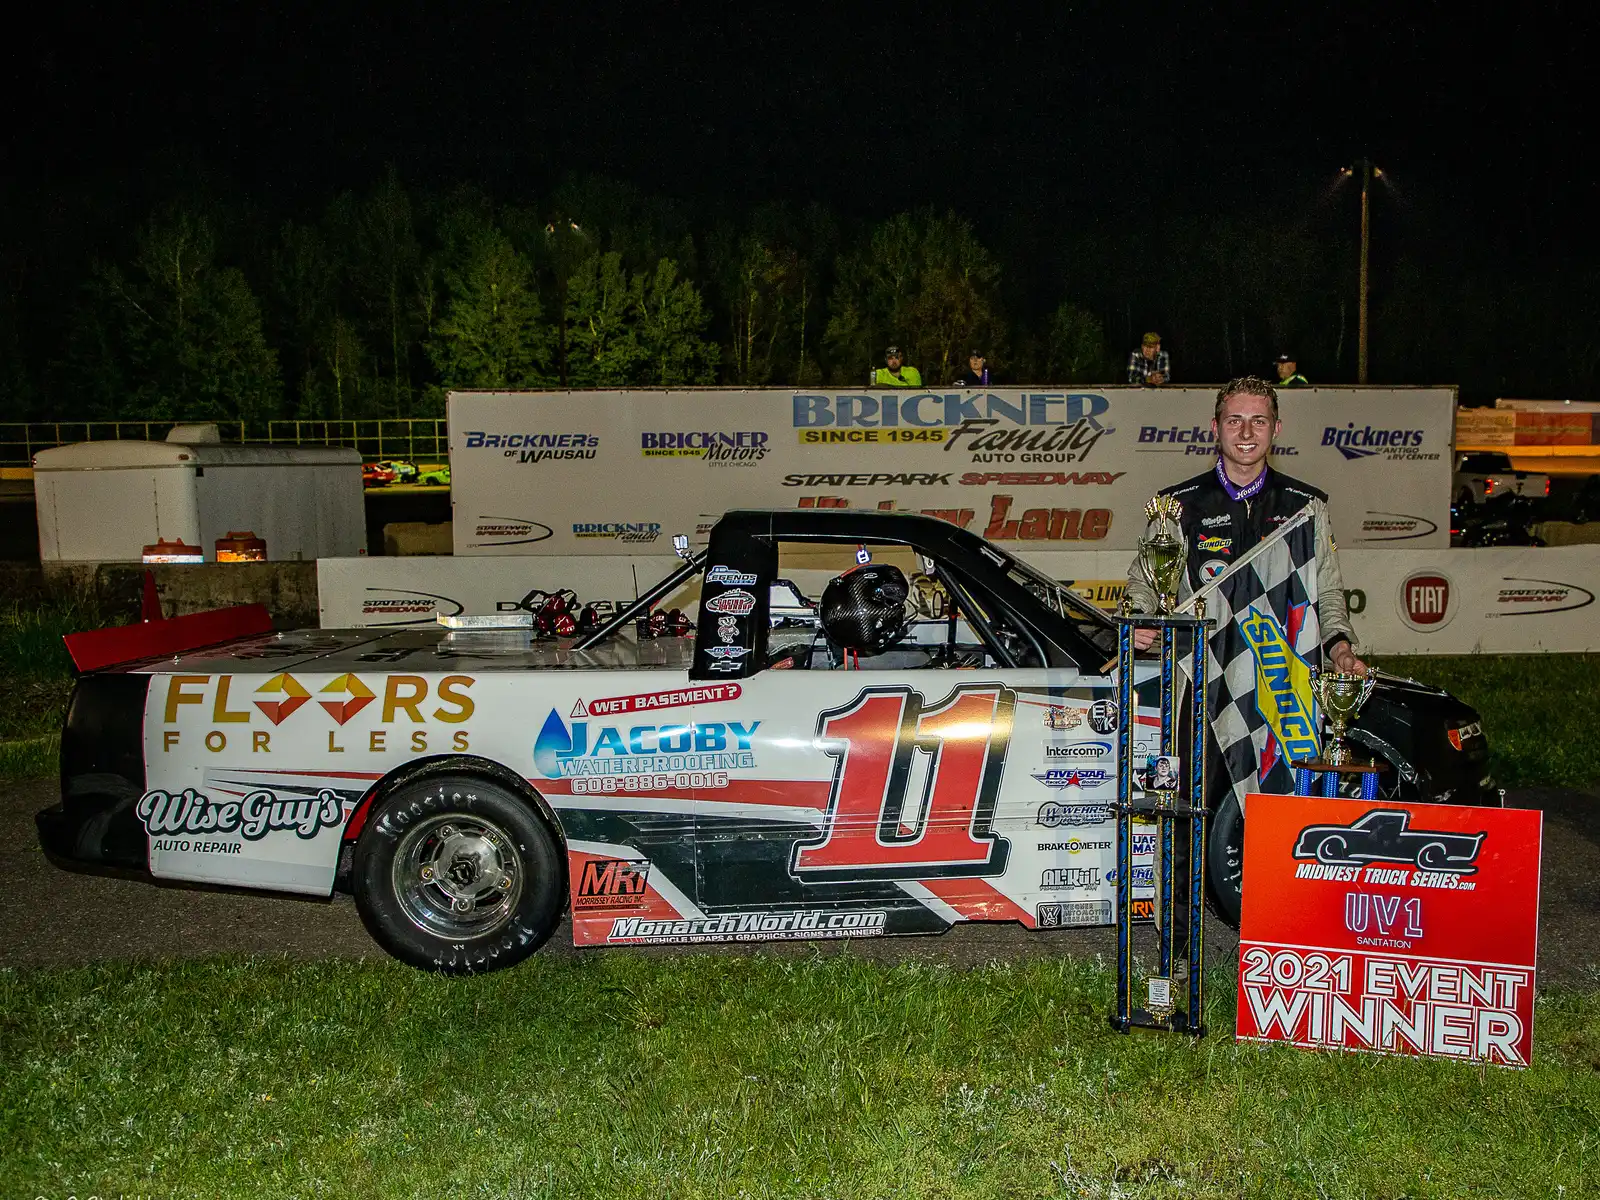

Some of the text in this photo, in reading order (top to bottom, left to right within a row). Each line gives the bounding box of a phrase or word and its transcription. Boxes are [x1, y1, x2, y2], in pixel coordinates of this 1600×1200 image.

[793, 394, 1116, 434] BRICKNER
[641, 432, 769, 449] BRICKNER
[805, 429, 943, 443] SINCE 1945
[944, 418, 1113, 462] Family
[1321, 422, 1424, 447] Brickners
[504, 449, 597, 464] OF WAUSAU
[702, 442, 771, 461] Motors
[972, 453, 1076, 463] AUTO GROUP
[781, 472, 1127, 487] STATEPARK SPEEDWAY
[983, 494, 1114, 541] Lane
[572, 523, 661, 534] BRICKNER
[1198, 539, 1232, 549] SUNOCO
[363, 599, 438, 607] STATEPARK
[1411, 585, 1446, 614] FIAT
[362, 606, 436, 614] SPEEDWAY
[1247, 621, 1317, 761] SUNOCO
[593, 699, 630, 714] WET
[163, 731, 470, 753] FOR LESS
[556, 720, 761, 758] JACOBY
[1046, 746, 1104, 758] Intercomp
[571, 772, 729, 794] 608-886-0016
[790, 684, 1013, 881] 11
[1046, 770, 1107, 780] FIVE STAR
[138, 790, 345, 840] Wise Guy's
[1063, 806, 1106, 814] WEHRS
[153, 840, 242, 854] AUTO REPAIR
[1295, 863, 1360, 883] MIDWEST
[1363, 867, 1408, 887] TRUCK
[576, 896, 645, 906] MORRISSEY RACING INC
[610, 910, 885, 938] MonarchWorld.com
[1345, 892, 1423, 938] UV1
[645, 936, 689, 944] VEHICLE
[689, 934, 728, 943] WRAPS
[794, 930, 824, 938] SIGNS
[835, 928, 883, 937] BANNERS
[1356, 936, 1412, 949] SANITATION
[1242, 947, 1528, 1010] 2021 EVENT
[1243, 985, 1528, 1067] WINNER
